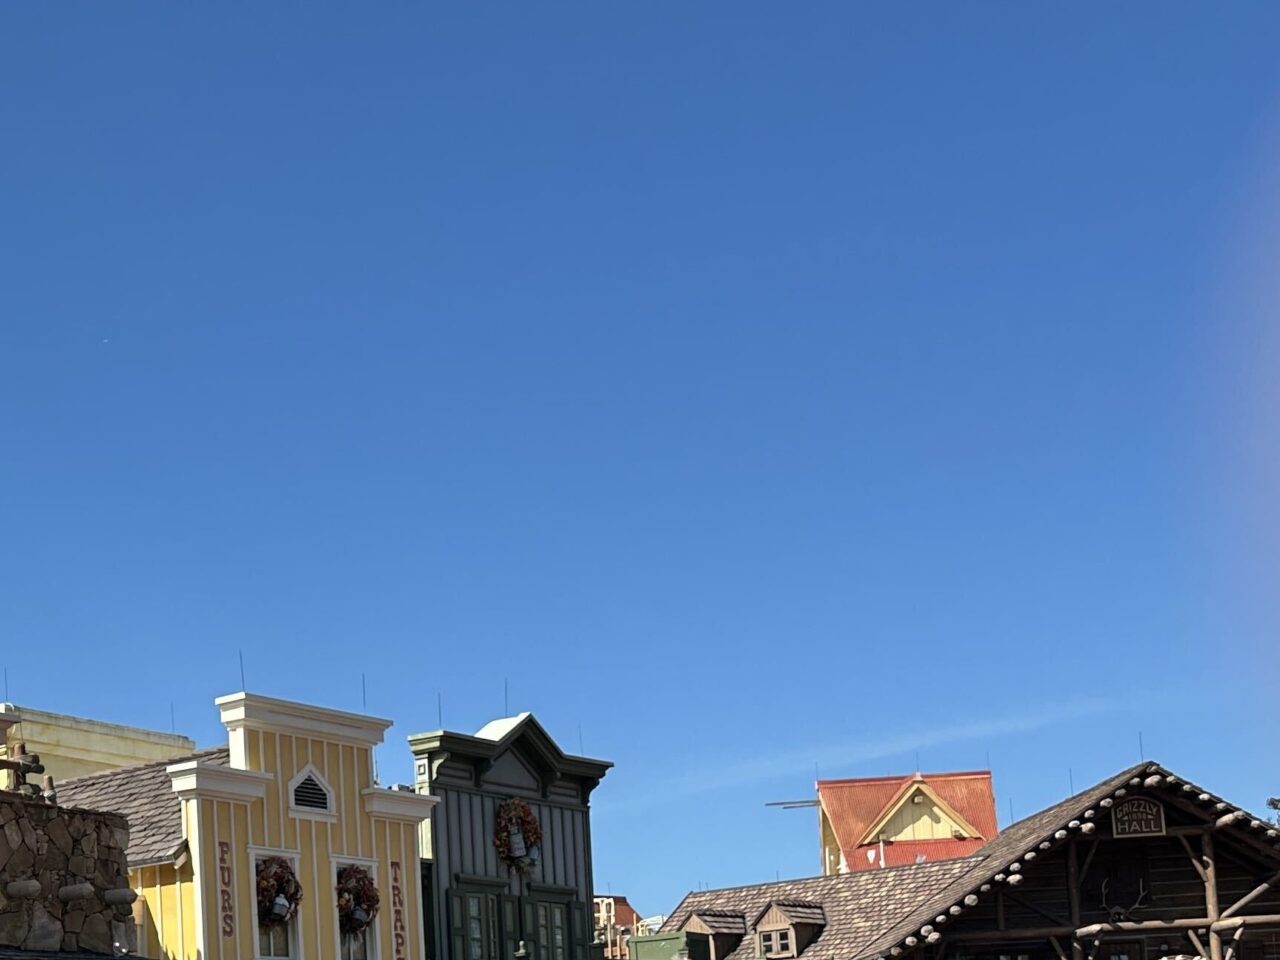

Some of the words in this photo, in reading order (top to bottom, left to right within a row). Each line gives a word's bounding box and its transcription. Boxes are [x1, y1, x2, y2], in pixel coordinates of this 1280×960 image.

[1116, 800, 1158, 818] GRIZZLY
[1117, 820, 1161, 833] HALL
[219, 841, 233, 937] FURS
